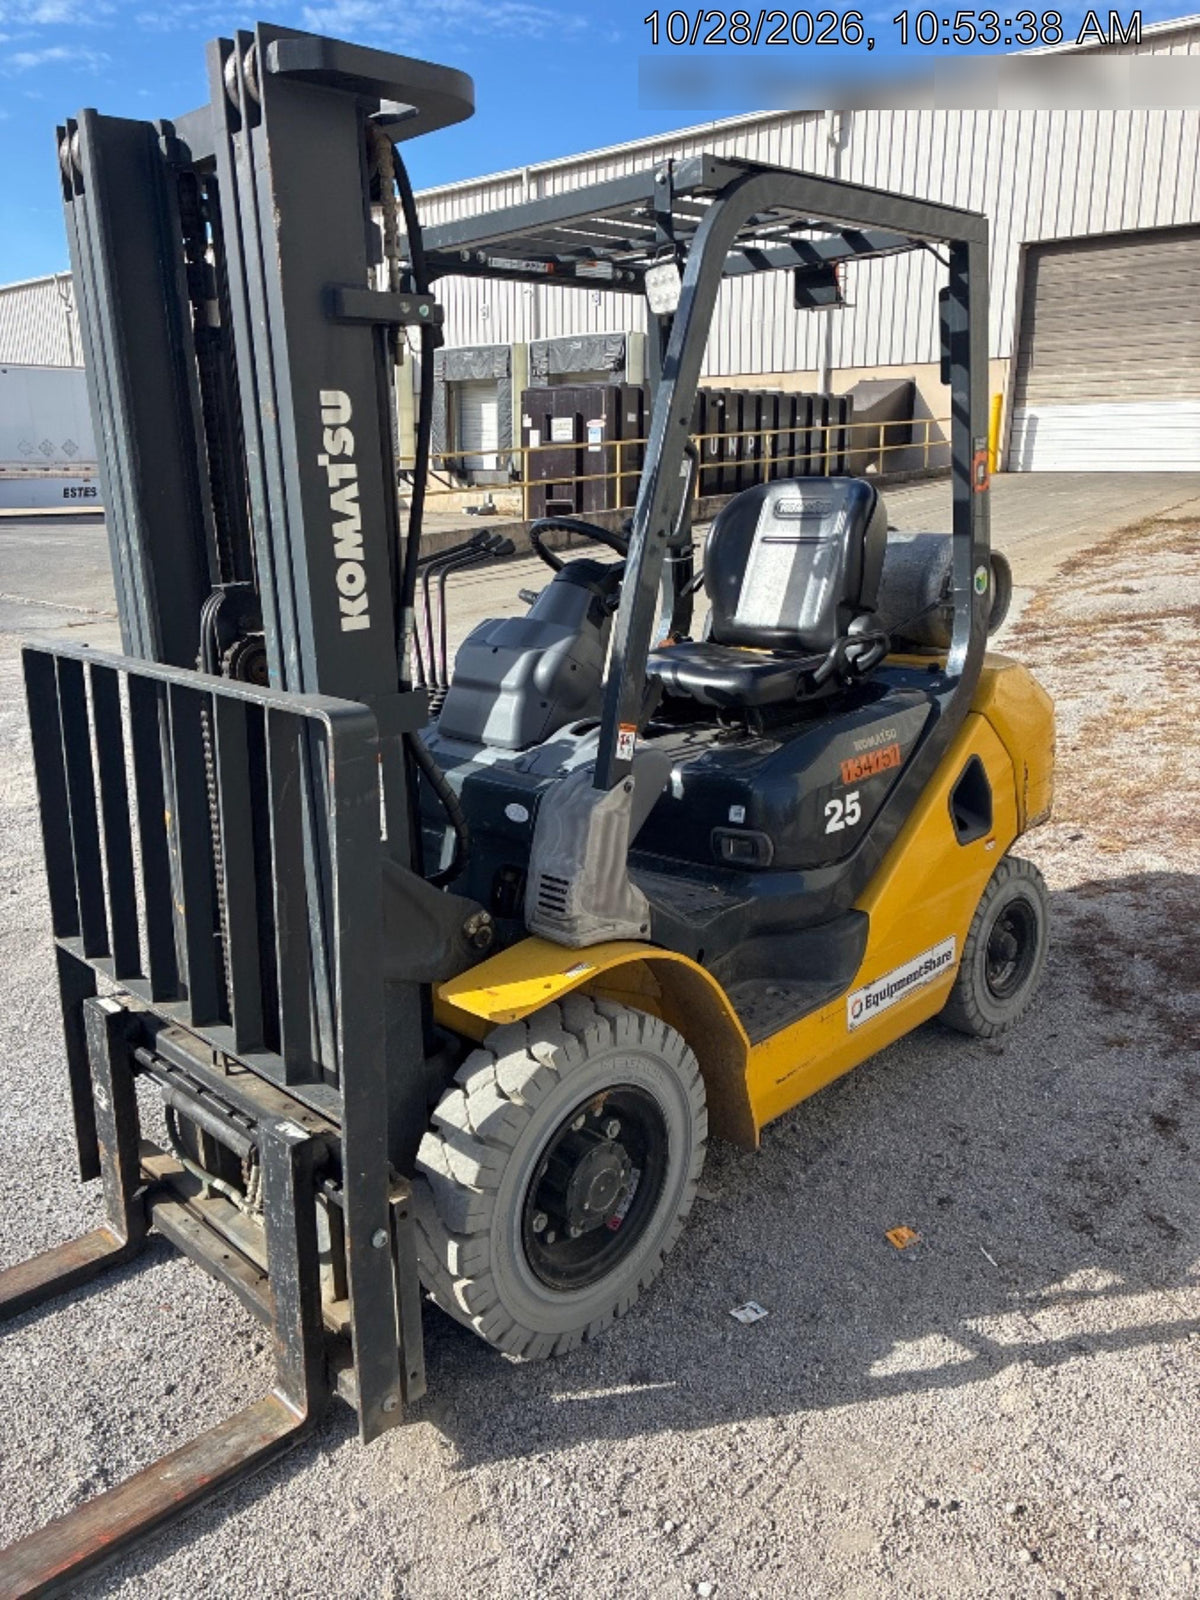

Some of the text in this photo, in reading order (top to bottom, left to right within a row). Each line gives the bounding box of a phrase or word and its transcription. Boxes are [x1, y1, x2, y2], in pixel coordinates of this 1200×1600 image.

[63, 487, 97, 498] ESTES
[317, 390, 371, 632] KOMATSU
[824, 790, 863, 834] 25
[865, 950, 953, 1010] EquipmentShare
